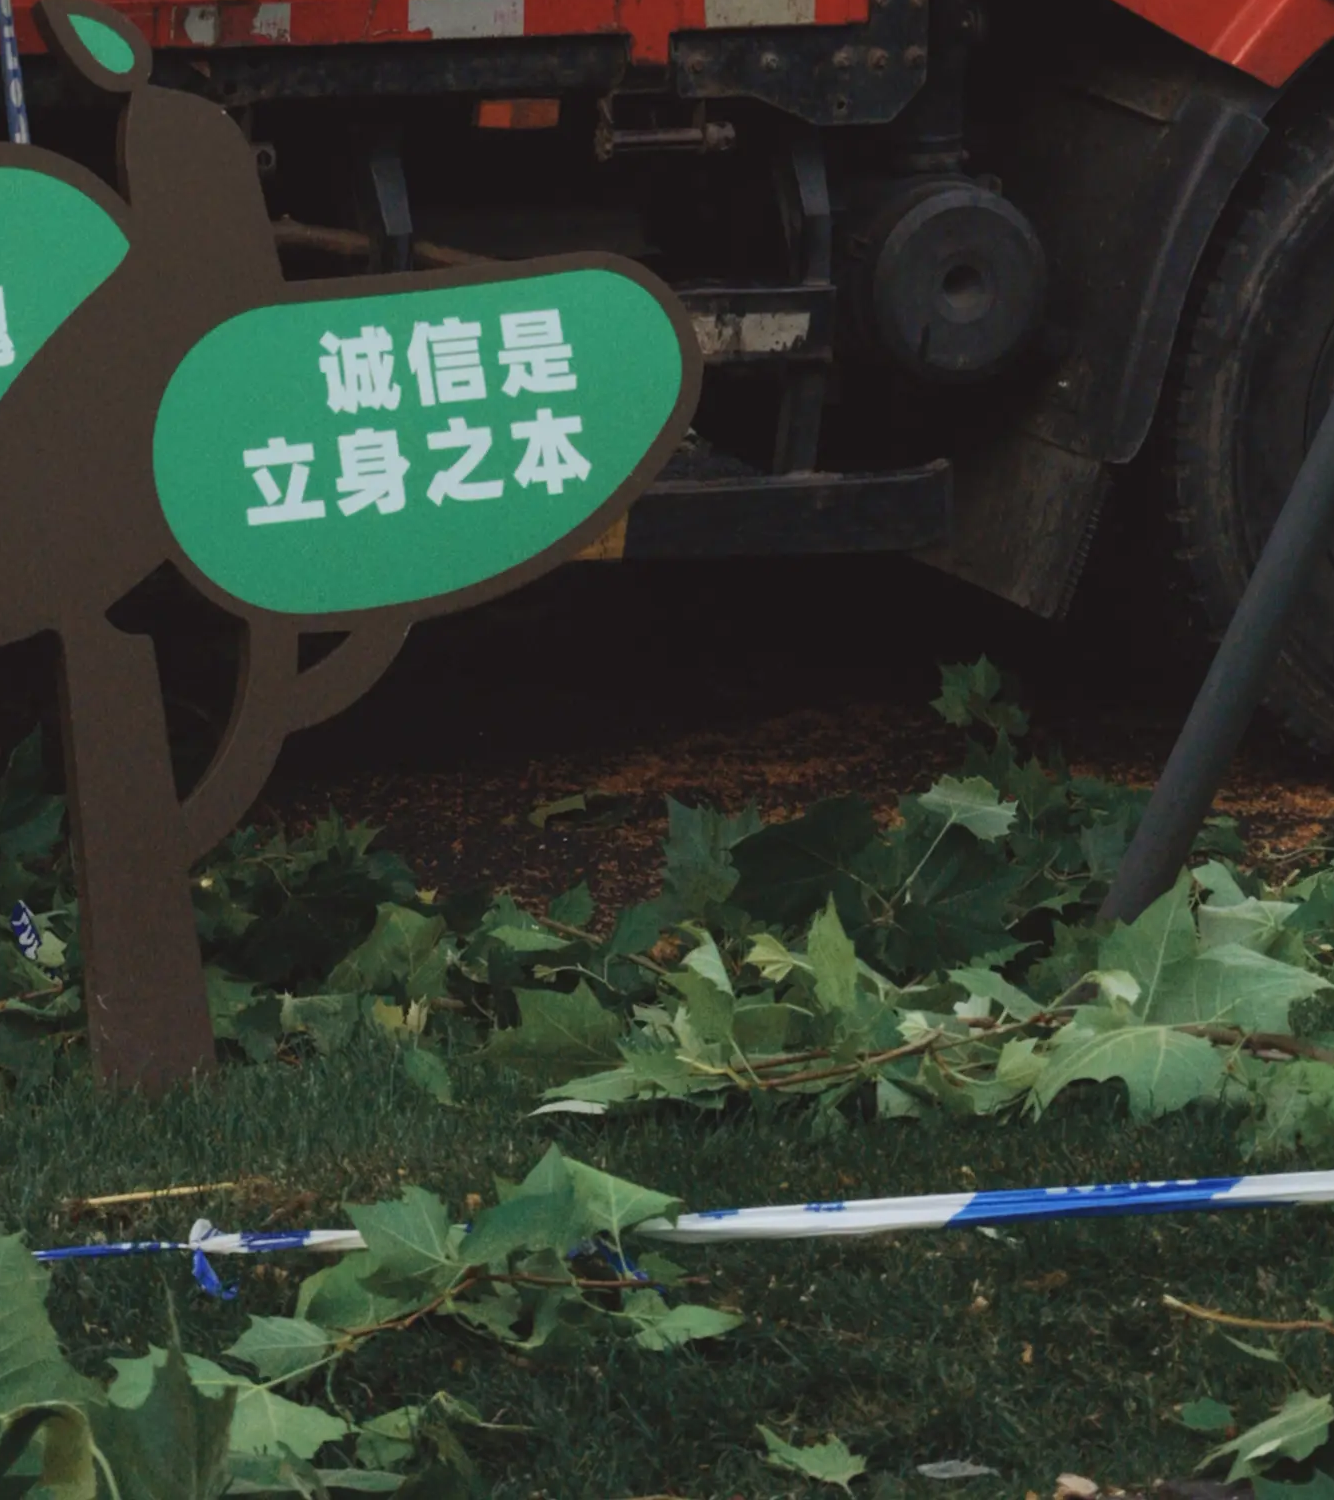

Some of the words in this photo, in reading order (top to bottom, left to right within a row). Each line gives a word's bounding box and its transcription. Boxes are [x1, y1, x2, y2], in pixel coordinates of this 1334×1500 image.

[318, 310, 578, 414] 诚信是
[242, 409, 593, 526] 立身之本
